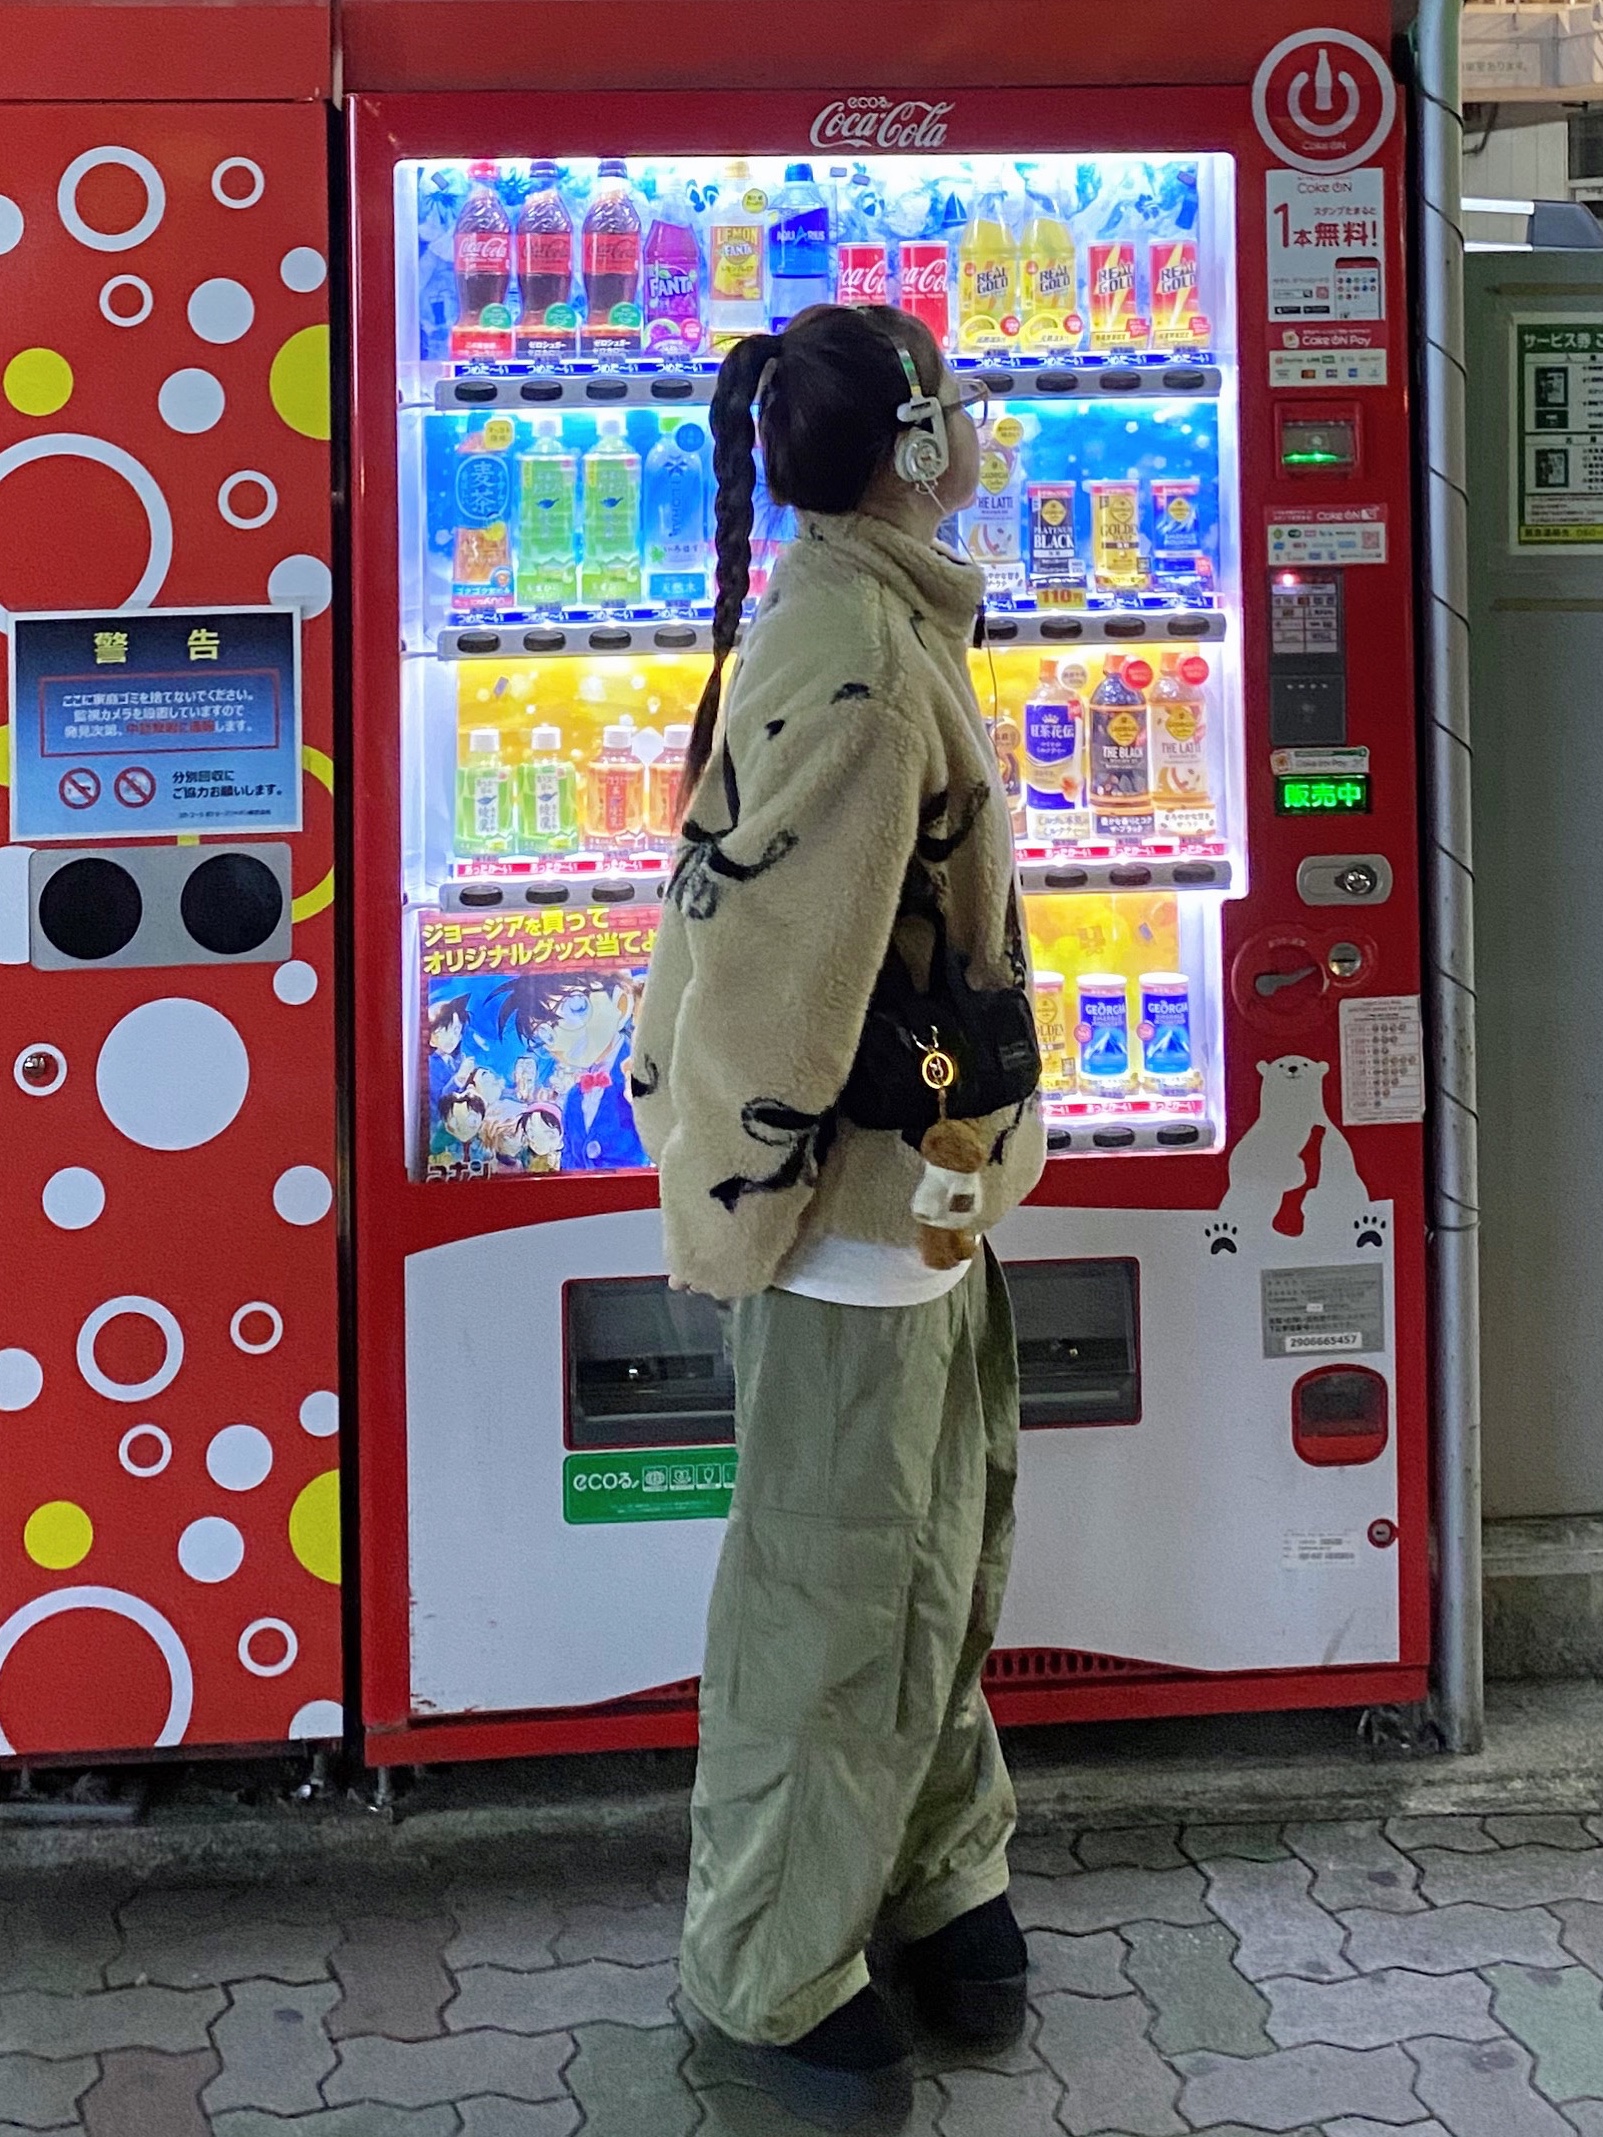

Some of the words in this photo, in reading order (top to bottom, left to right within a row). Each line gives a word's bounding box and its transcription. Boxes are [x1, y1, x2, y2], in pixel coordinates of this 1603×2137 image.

[809, 101, 956, 148] Coca-Cola
[1297, 183, 1330, 194] Coke
[1332, 181, 1353, 193] ON
[1273, 202, 1378, 248] 1本無料!
[717, 228, 757, 245] LEMON
[776, 225, 826, 246] AQUARIUS
[976, 266, 1006, 283] REAL
[1039, 264, 1068, 282] REAL
[1098, 261, 1135, 280] REAL
[1161, 258, 1196, 281] REAL
[650, 276, 694, 297] FANTA
[977, 278, 1008, 295] GOLD
[1039, 276, 1071, 293] GOLD
[1098, 276, 1135, 295] GOLD
[1302, 336, 1330, 346] Coke
[1331, 335, 1348, 346] ON
[1349, 335, 1371, 347] Pay
[471, 461, 495, 514] 麦茶
[1034, 534, 1075, 549] BLACK
[663, 582, 696, 594] 天然水
[94, 631, 129, 664] 警
[187, 628, 221, 661] 告
[62, 689, 254, 707] ここに家庭ゴミを捨てないでください。
[73, 704, 246, 722] 監視カメラを設置していますので
[1030, 724, 1075, 738] 紅茶花伝
[1102, 745, 1119, 758] THE
[1161, 743, 1177, 754] THE
[172, 770, 234, 783] 分別回収に
[172, 784, 282, 799] ご協力お願いします。
[1284, 783, 1361, 808] 販売中
[421, 906, 610, 947] ジョージアを買って
